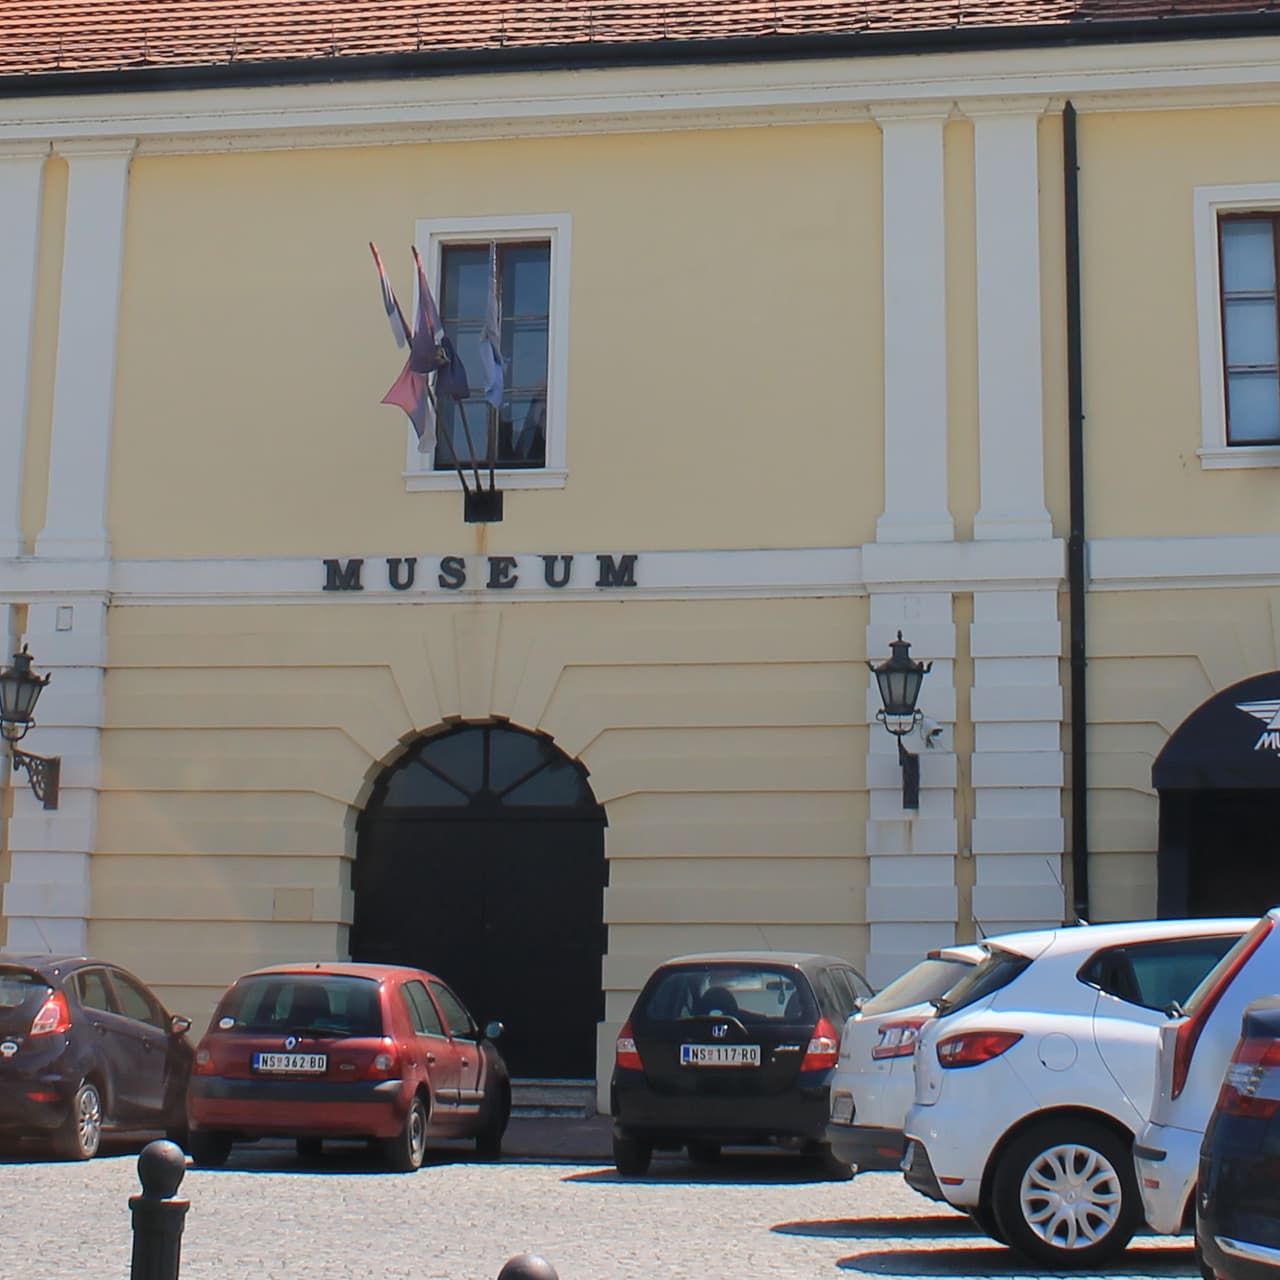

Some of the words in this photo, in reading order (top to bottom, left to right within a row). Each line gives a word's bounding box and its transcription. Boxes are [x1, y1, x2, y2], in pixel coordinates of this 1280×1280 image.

[322, 555, 638, 591] MUSEUM
[692, 1048, 706, 1060] NS
[262, 1055, 276, 1068] NS
